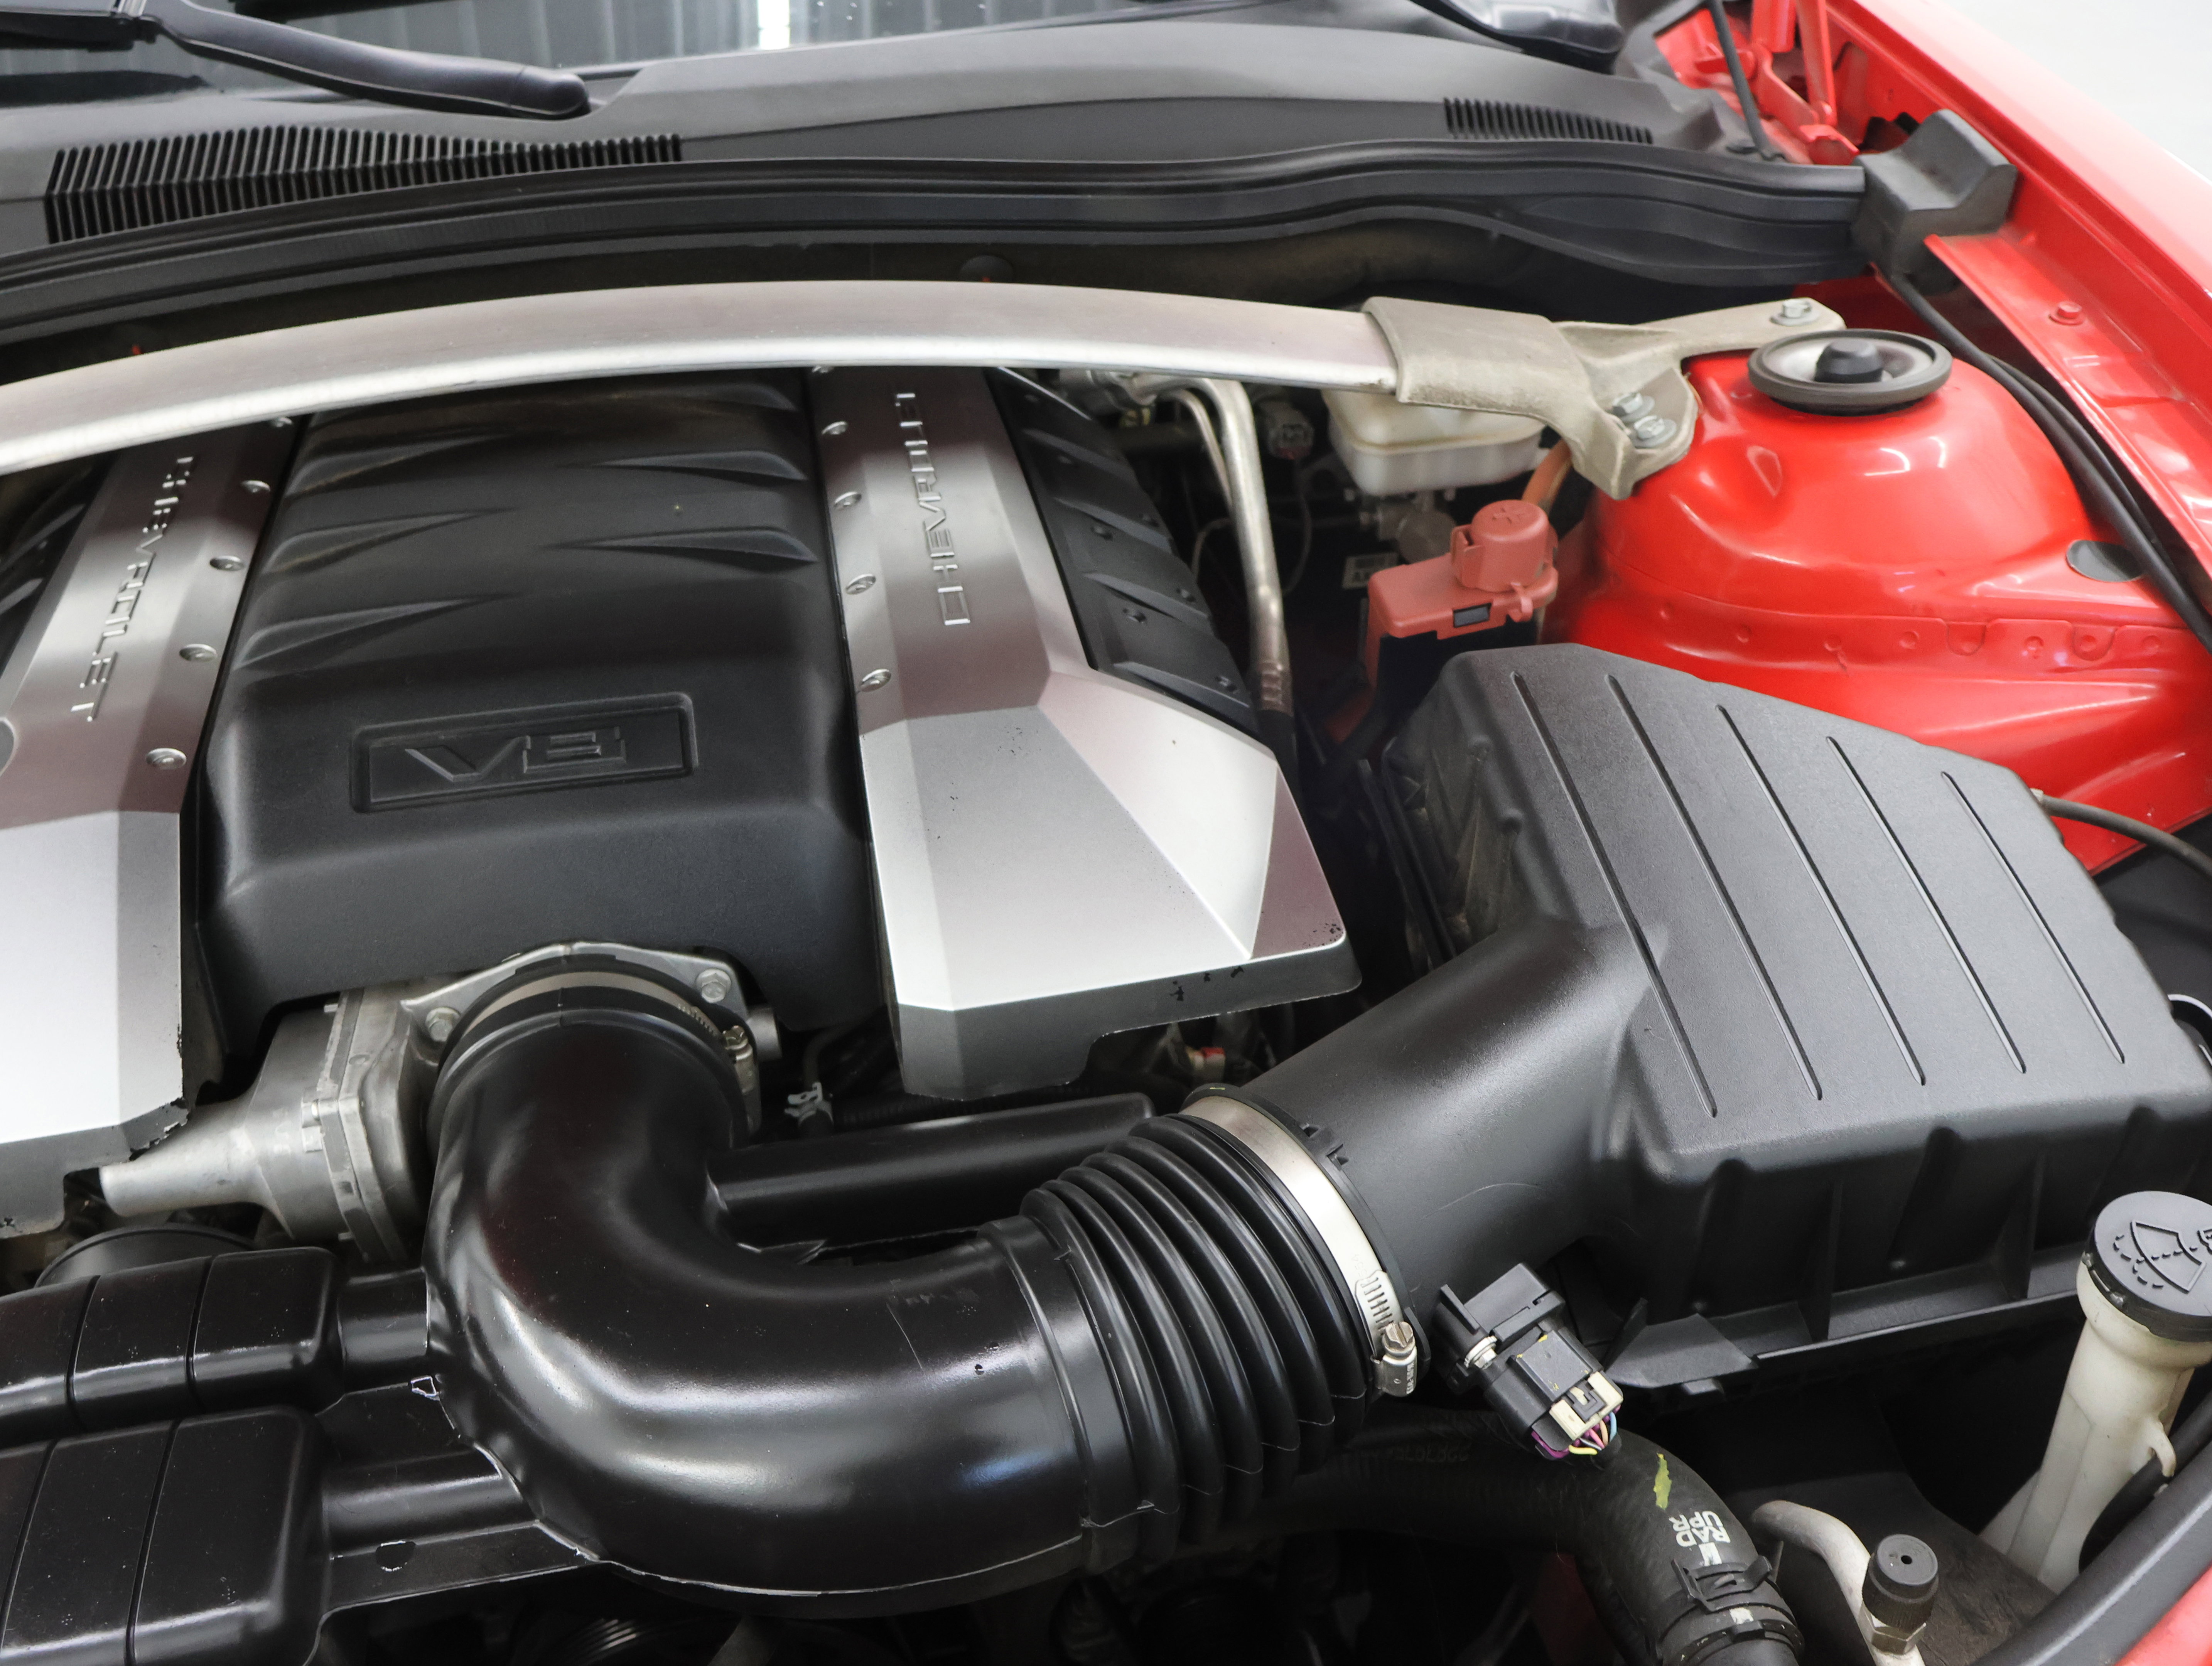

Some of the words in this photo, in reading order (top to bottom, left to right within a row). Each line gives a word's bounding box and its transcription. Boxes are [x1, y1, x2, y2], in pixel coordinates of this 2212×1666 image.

[895, 393, 971, 626] CHEVROLET
[71, 456, 194, 721] CHEVROLET
[405, 726, 626, 783] V8
[1668, 1511, 1723, 1531] UPR
[1675, 1526, 1731, 1547] RAD
